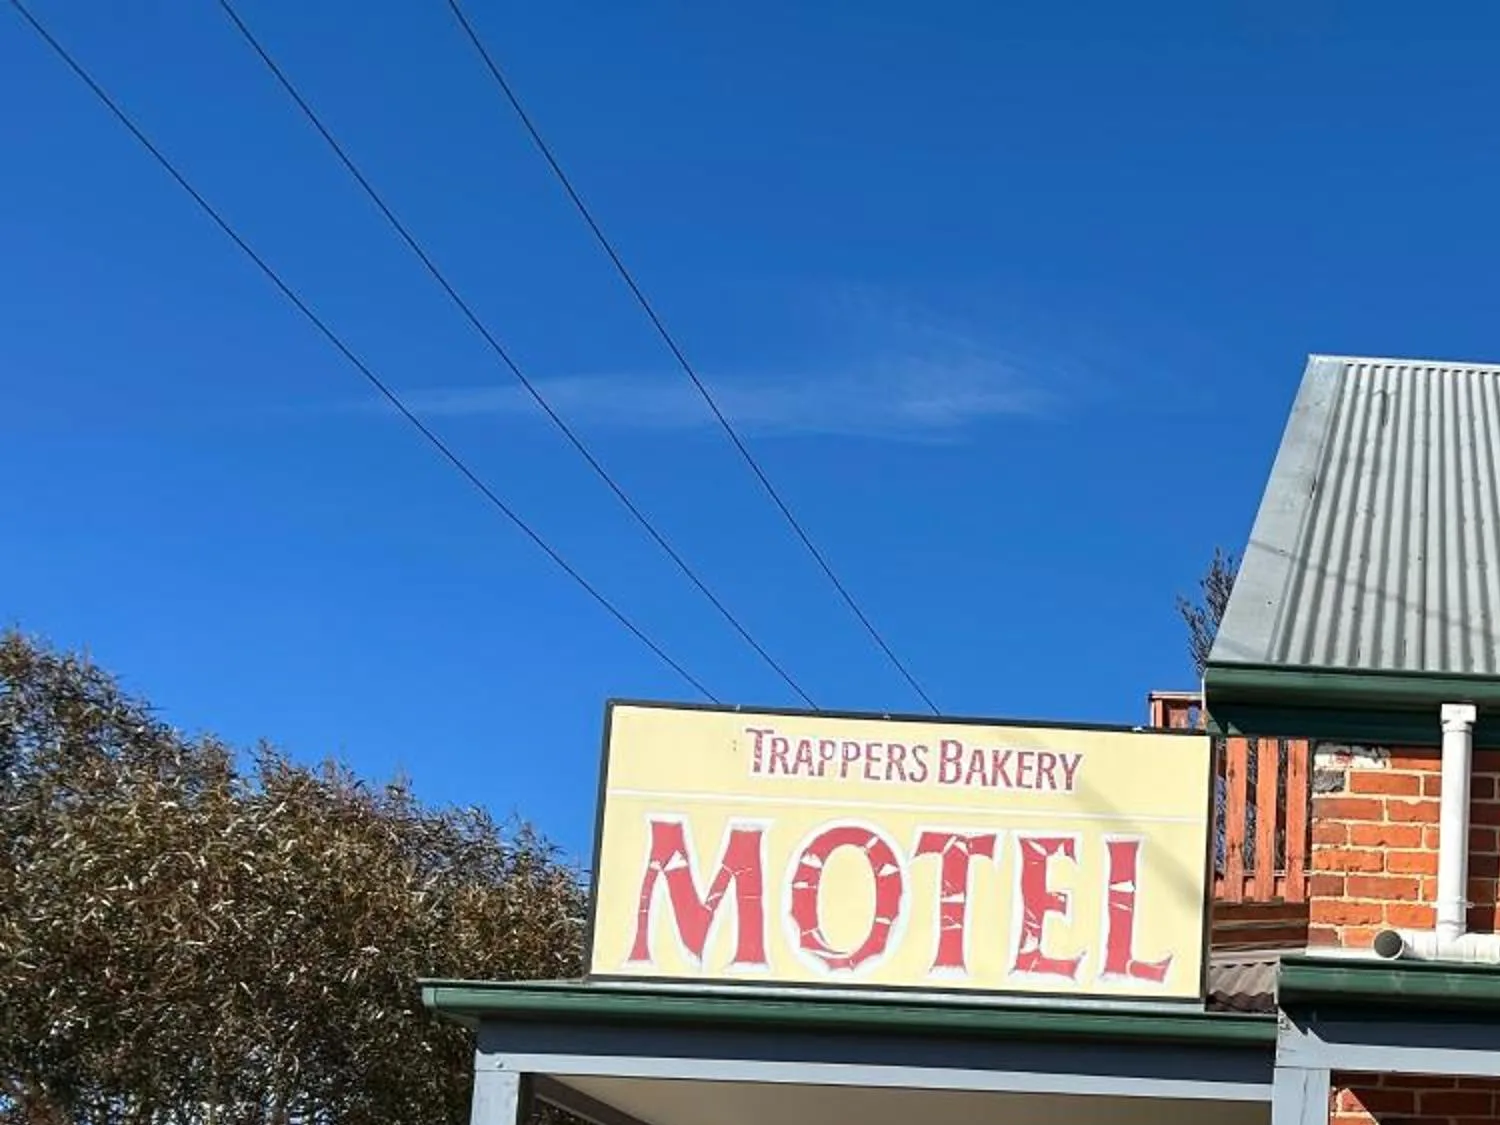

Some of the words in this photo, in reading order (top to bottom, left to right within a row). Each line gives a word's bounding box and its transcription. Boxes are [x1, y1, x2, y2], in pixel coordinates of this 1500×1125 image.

[745, 728, 928, 784] TRAPPERS
[937, 739, 1083, 791] BAKERY
[627, 820, 1173, 983] MOTEL
